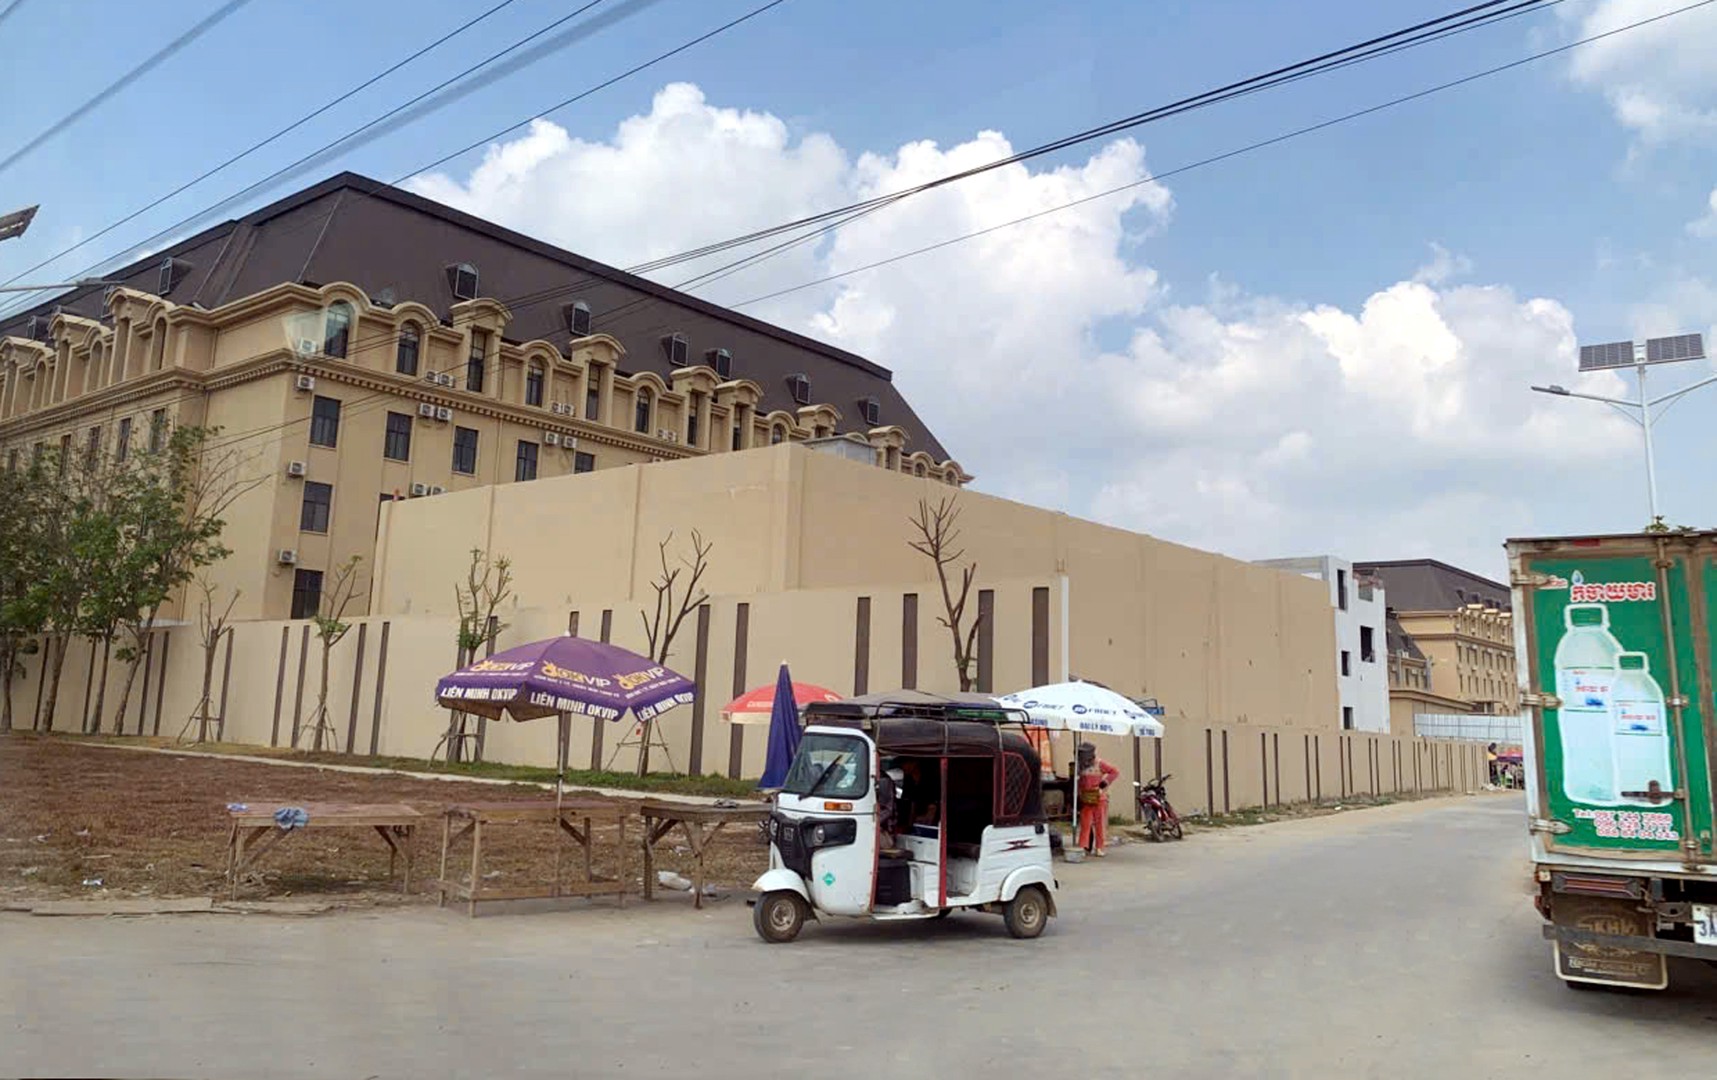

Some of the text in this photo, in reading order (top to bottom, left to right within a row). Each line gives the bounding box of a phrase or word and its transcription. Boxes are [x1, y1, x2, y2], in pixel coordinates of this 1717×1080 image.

[440, 684, 518, 700] LIÊN MINH OKVIP
[530, 691, 619, 720] LIÊN MINH OKVIP
[636, 704, 657, 722] LIÊN
